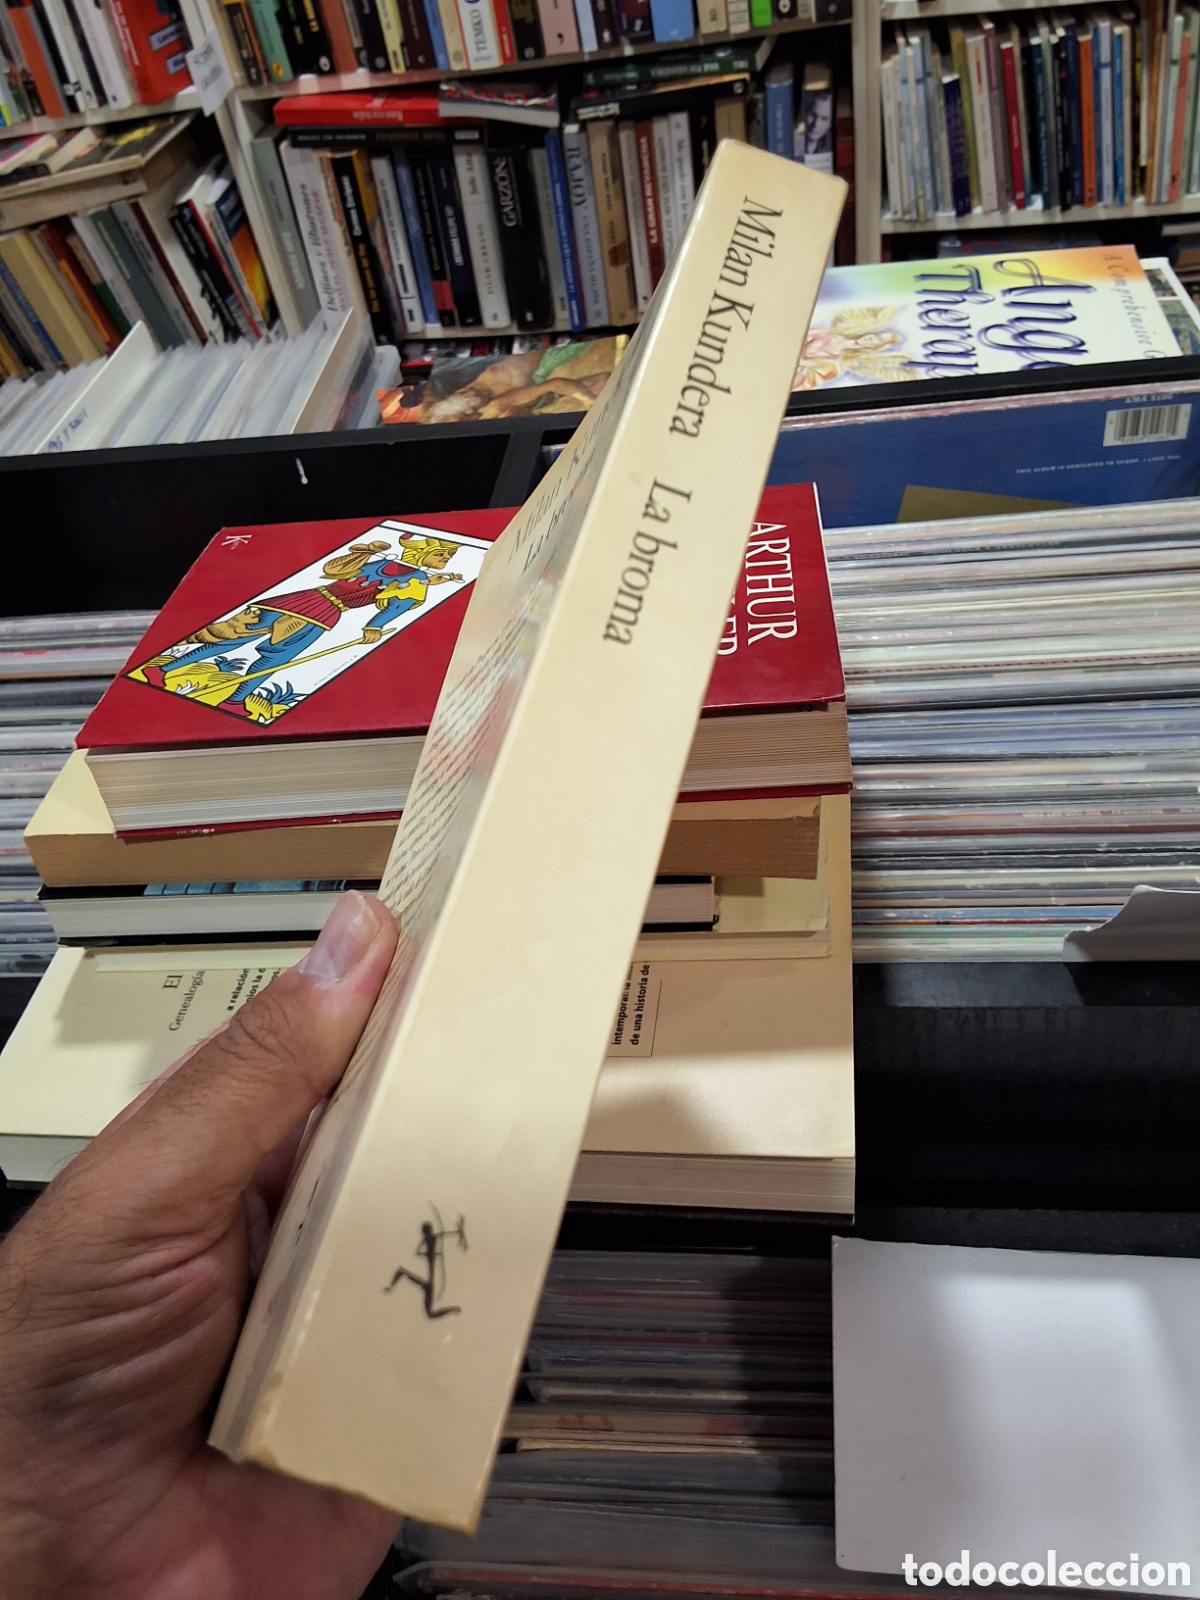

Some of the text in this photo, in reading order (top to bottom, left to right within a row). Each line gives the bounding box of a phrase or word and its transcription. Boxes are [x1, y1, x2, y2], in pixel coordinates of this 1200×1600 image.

[473, 9, 488, 54] TEMKO
[566, 147, 587, 206] RAJOY
[669, 194, 784, 438] Milan Kundera
[976, 258, 1097, 370] Ang
[1107, 264, 1153, 346] Comprehensive
[602, 477, 693, 646] La broma
[745, 521, 798, 646] ARTHUR
[162, 974, 183, 990] El
[168, 969, 206, 1032] Genealogía
[226, 968, 250, 1012] a relación
[252, 974, 263, 984] la
[629, 964, 651, 1046] de una historia de
